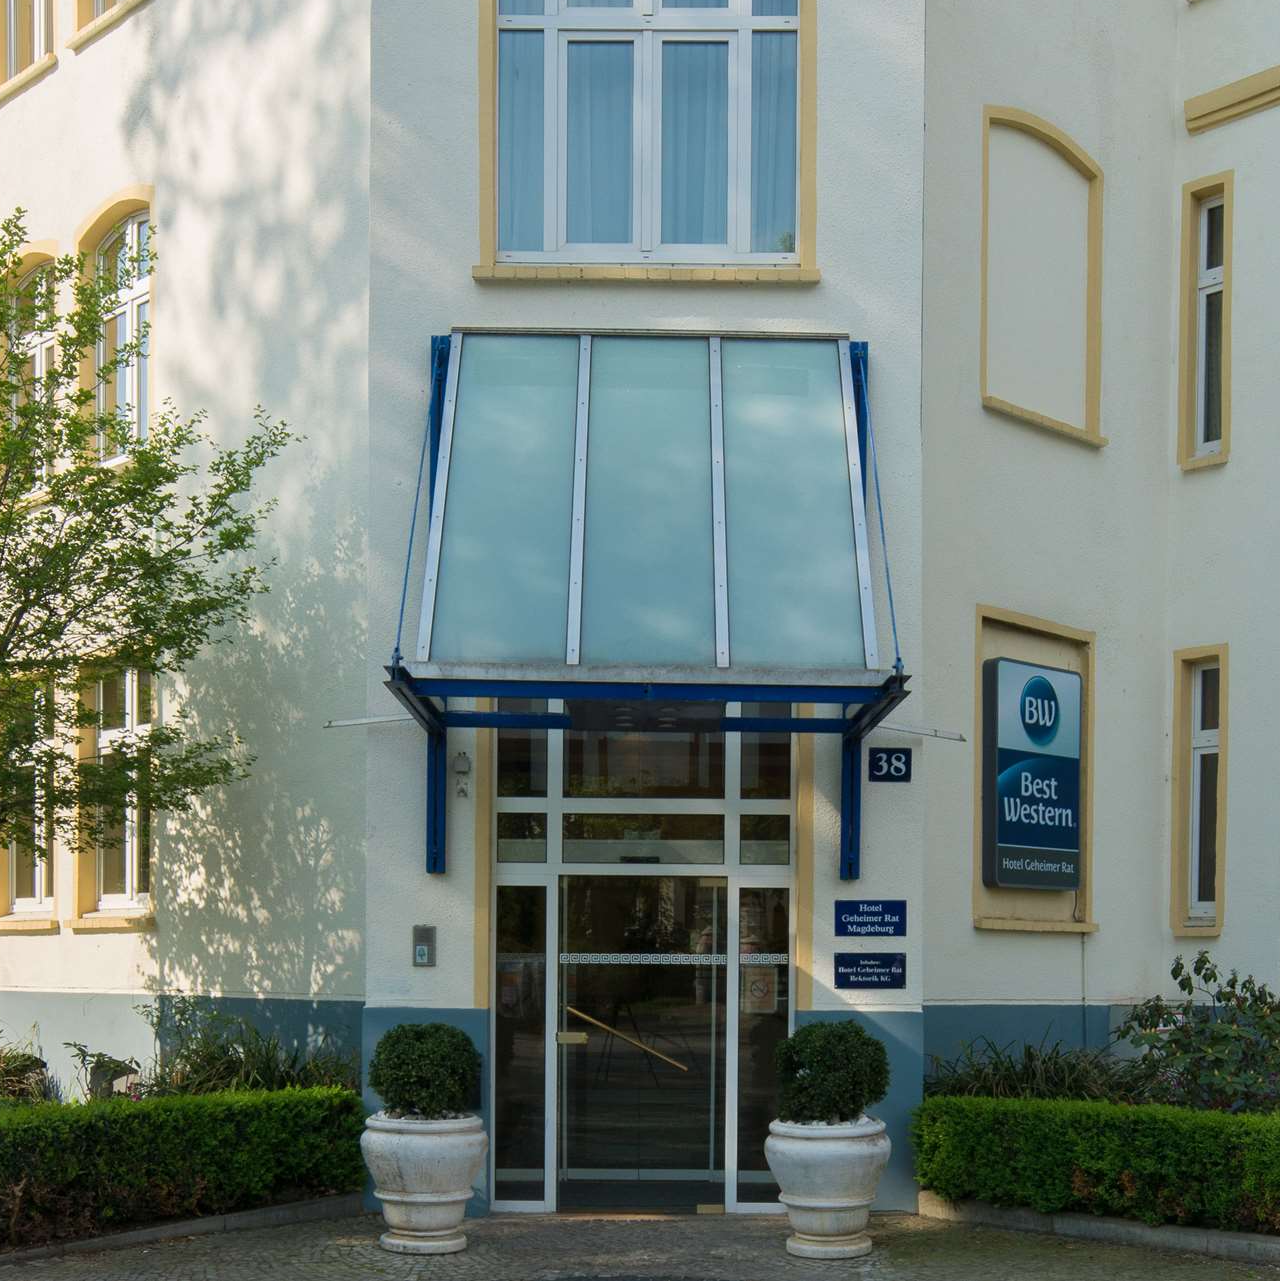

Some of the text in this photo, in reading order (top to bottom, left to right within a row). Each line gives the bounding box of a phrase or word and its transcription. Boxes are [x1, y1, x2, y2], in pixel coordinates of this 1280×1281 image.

[1025, 696, 1056, 727] BW
[872, 752, 906, 776] 38
[1021, 771, 1059, 800] Best
[1003, 796, 1073, 828] Western
[1002, 857, 1075, 874] Hotel Geheimer Rat
[859, 903, 883, 912] Hotel
[841, 913, 900, 923] Geheimer Rat
[847, 924, 895, 935] Magdeburg
